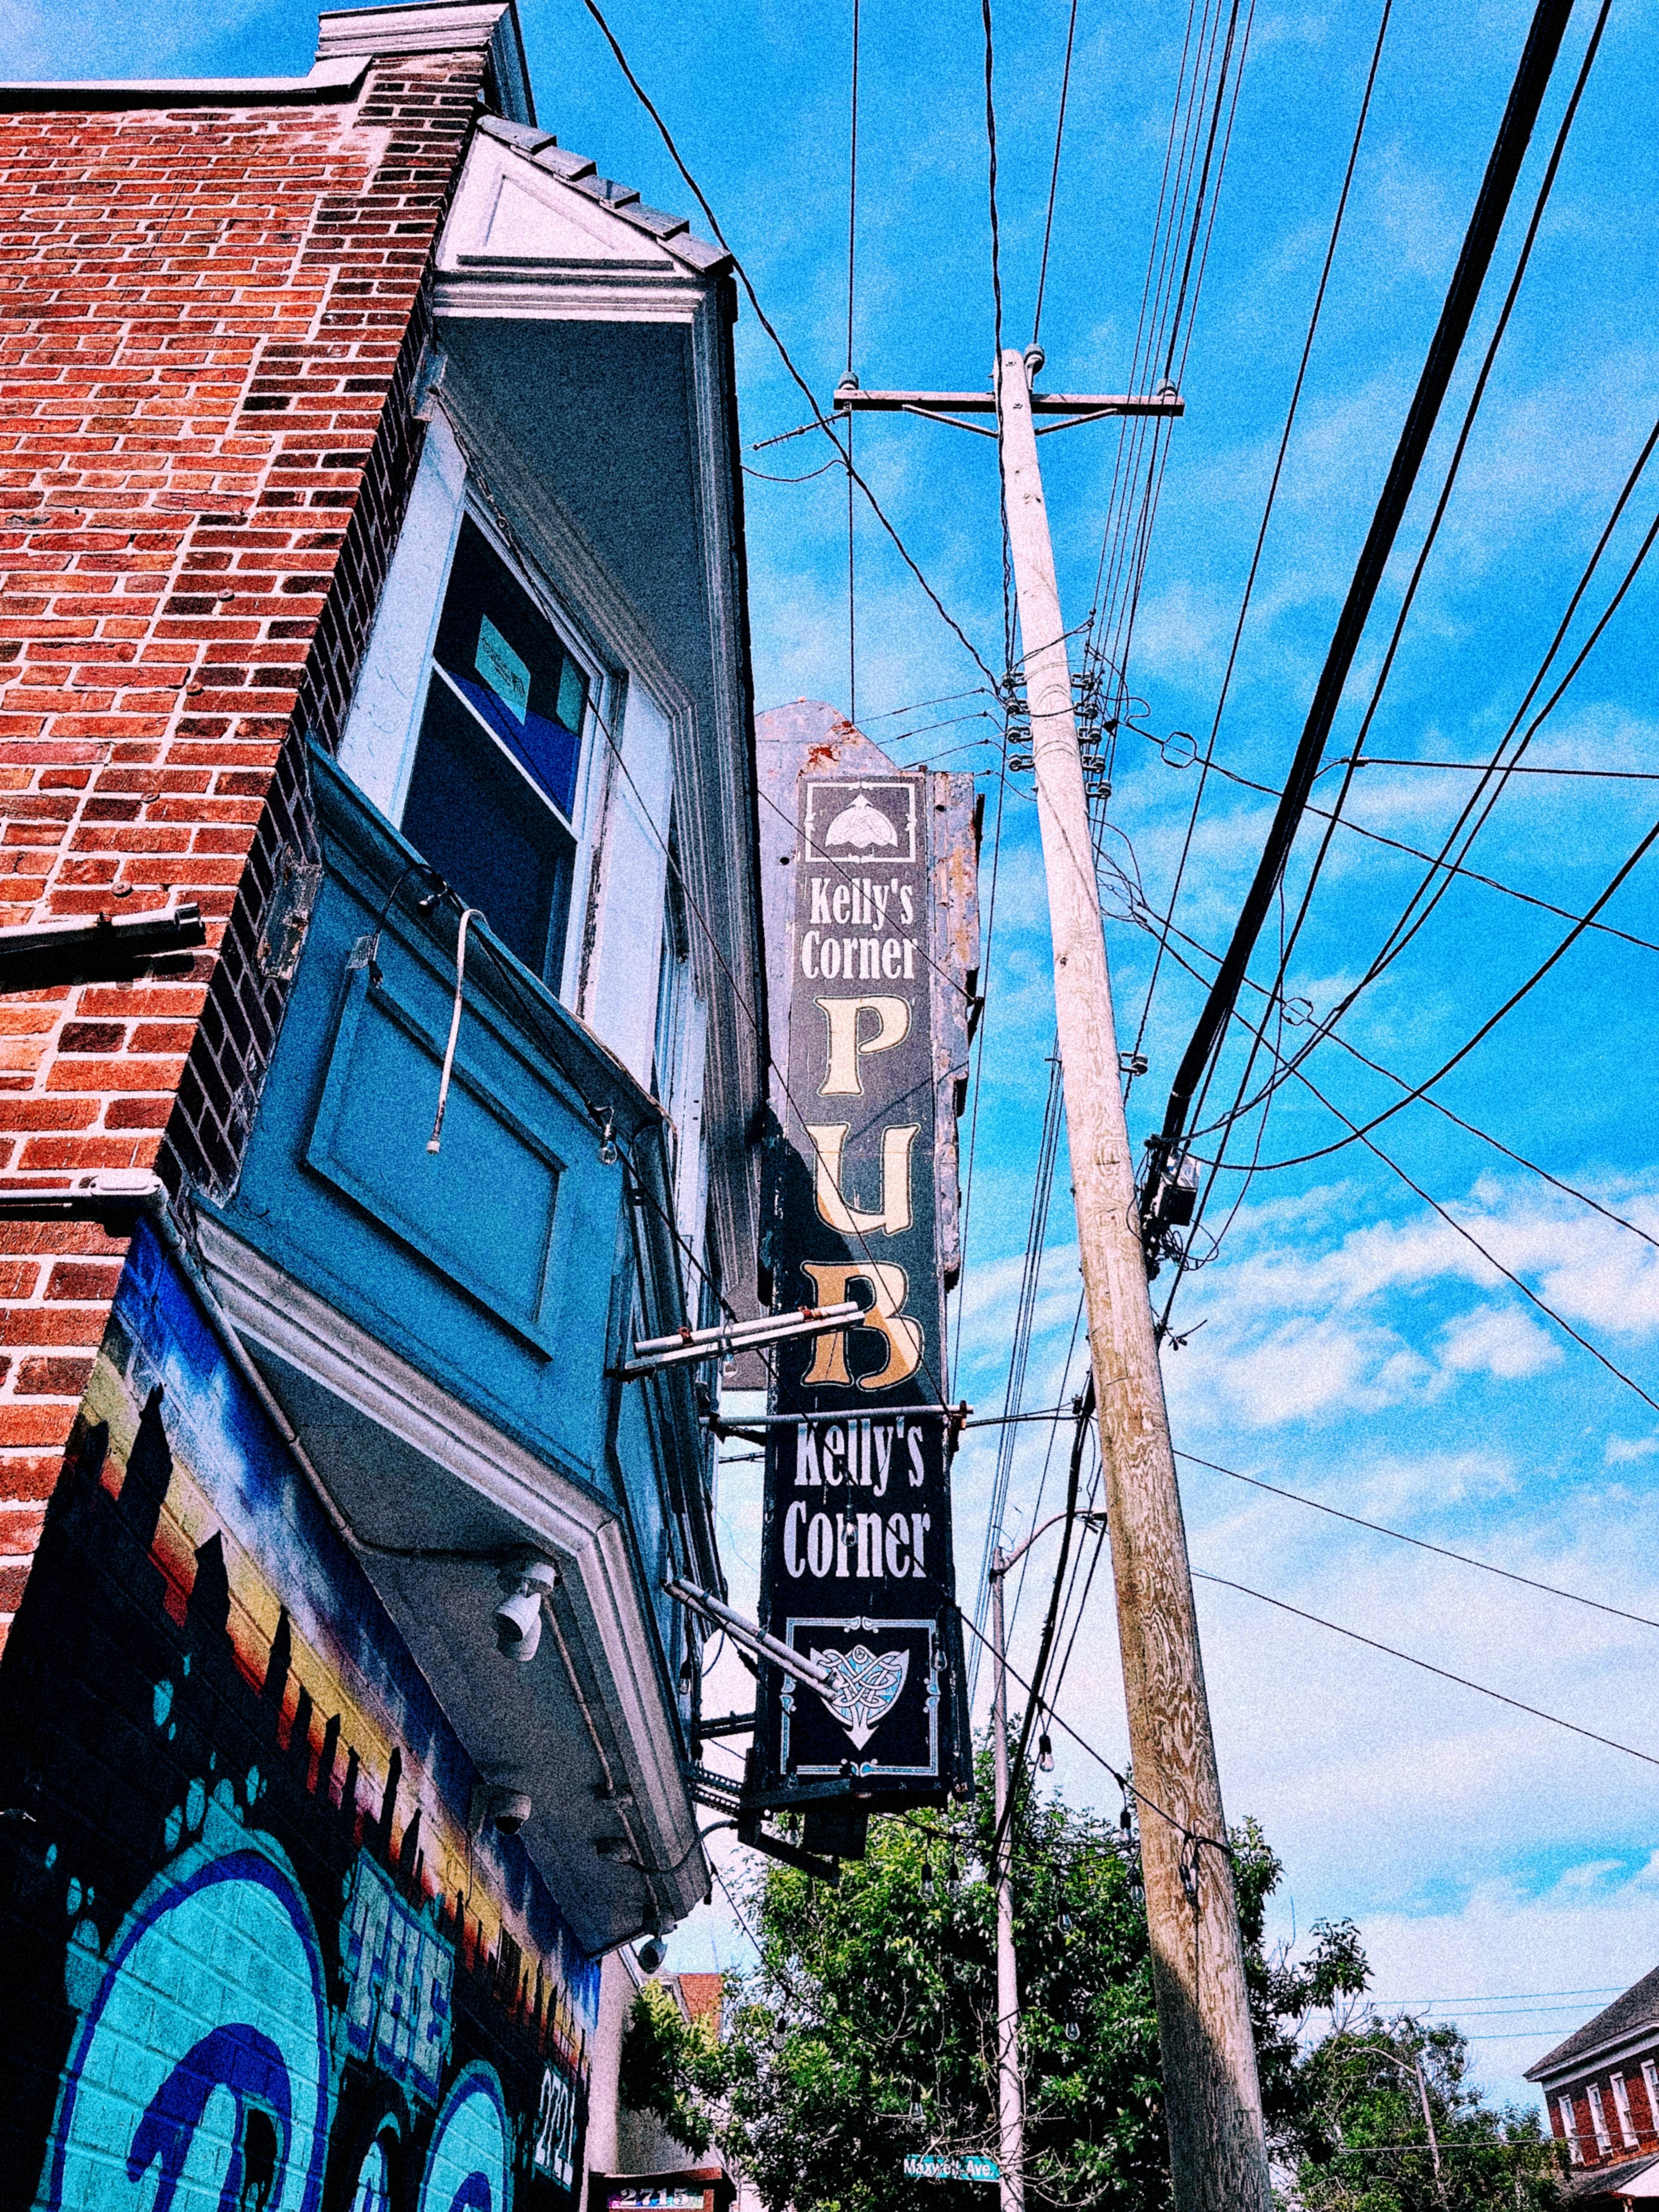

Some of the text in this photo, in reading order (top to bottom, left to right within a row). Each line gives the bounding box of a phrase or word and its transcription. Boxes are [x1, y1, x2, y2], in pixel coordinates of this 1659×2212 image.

[809, 877, 915, 930] Kelly's
[802, 930, 918, 980] Corner
[800, 994, 924, 1392] PUB
[794, 1415, 924, 1497] Kelly's
[783, 1500, 932, 1579] Corner
[349, 1861, 452, 2084] THE
[620, 2188, 690, 2207] 2715
[966, 2160, 995, 2177] Ave.
